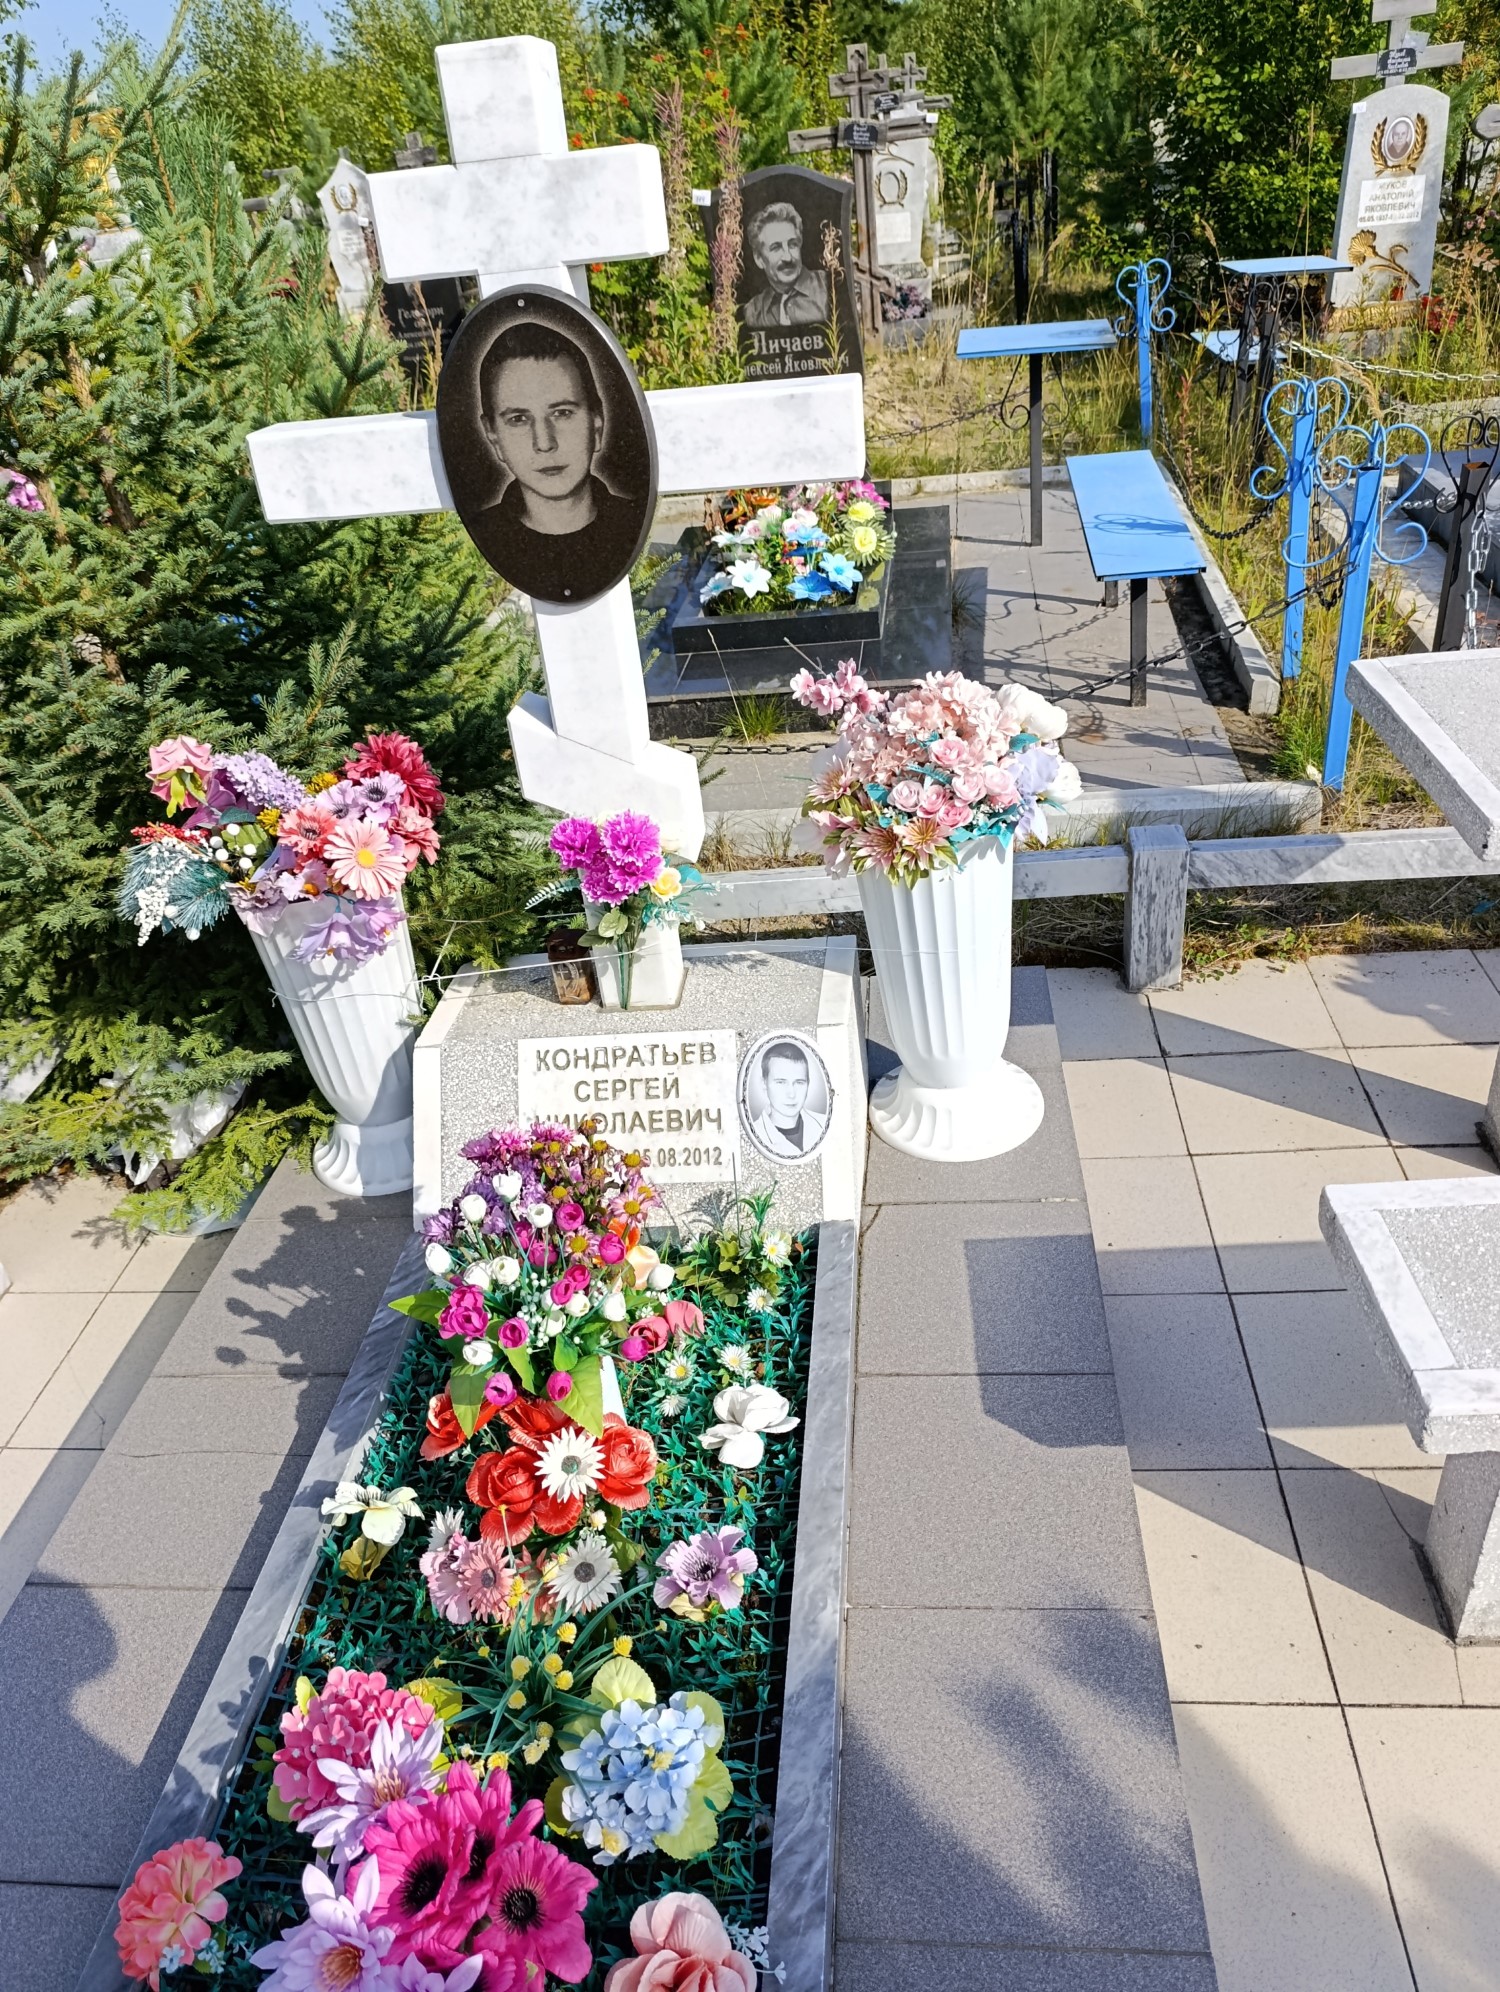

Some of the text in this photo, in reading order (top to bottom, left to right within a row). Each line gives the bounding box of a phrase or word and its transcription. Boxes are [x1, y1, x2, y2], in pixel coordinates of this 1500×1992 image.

[1369, 189, 1415, 202] АНАТОЛИЙ
[1364, 202, 1416, 213] ЯКОВЛЕВИЧ
[751, 331, 824, 356] Личаев
[744, 358, 782, 377] лексей
[536, 1042, 717, 1072] КОНДРАТЬЕВ
[574, 1073, 680, 1102] СЕРГЕЙ
